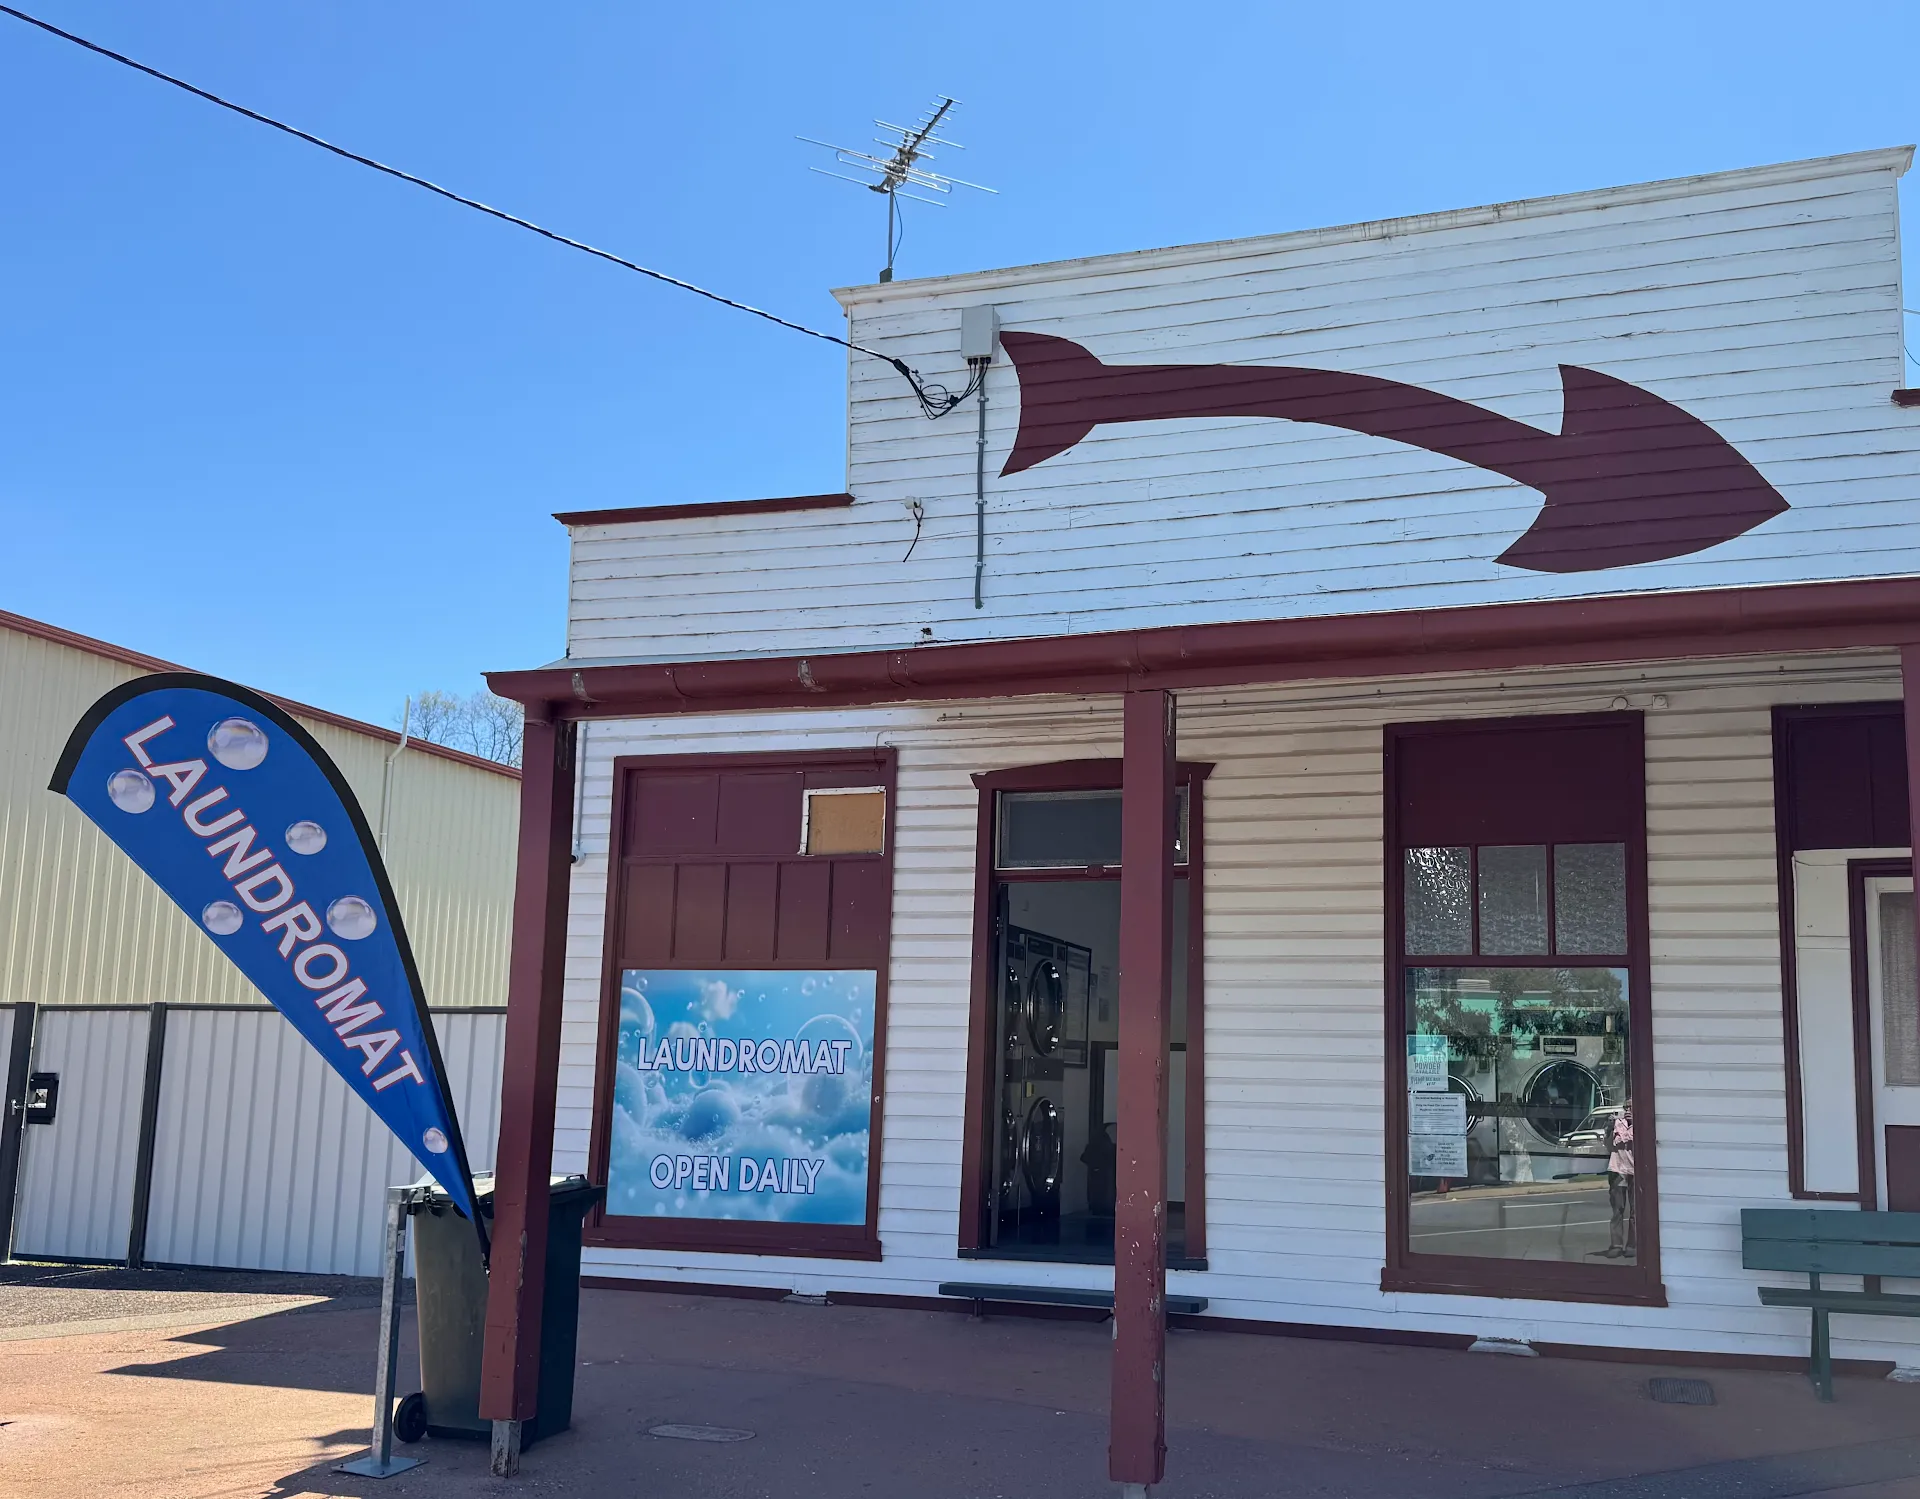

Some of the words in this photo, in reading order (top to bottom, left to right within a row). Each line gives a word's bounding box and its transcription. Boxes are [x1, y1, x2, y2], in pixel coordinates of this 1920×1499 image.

[123, 715, 423, 1092] LAUNDROMAT
[637, 1037, 852, 1074] LAUNDROMAT
[1414, 1062, 1441, 1070] POWDER
[649, 1154, 729, 1191] OPEN
[738, 1156, 824, 1194] DAILY
